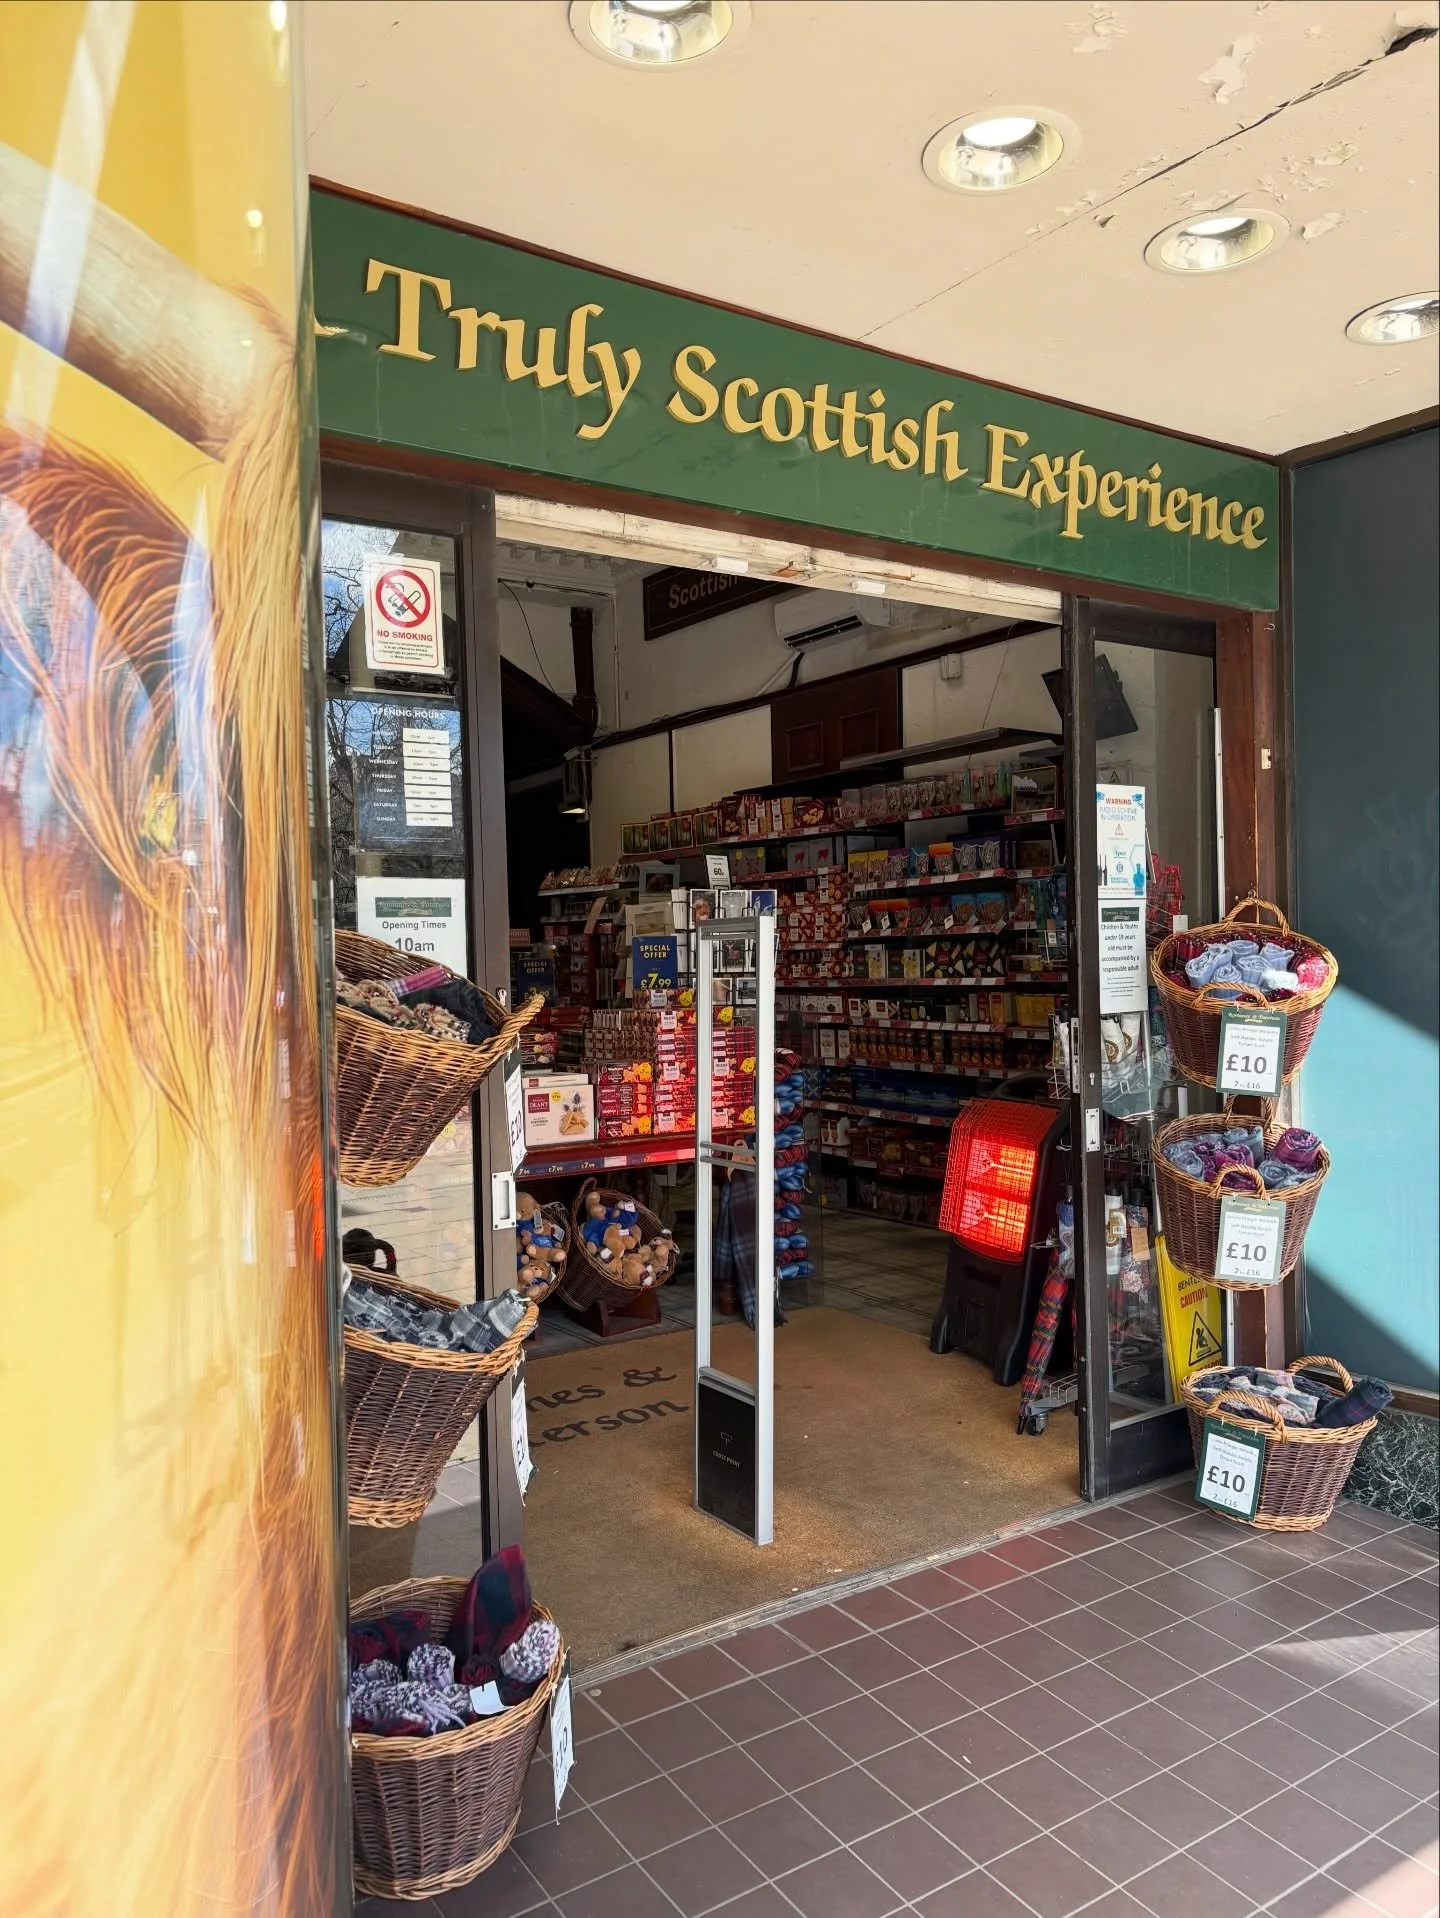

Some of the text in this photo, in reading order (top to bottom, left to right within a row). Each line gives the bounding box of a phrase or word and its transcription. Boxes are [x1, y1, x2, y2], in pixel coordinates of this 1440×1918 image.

[364, 259, 1268, 550] Truly Scottish Experience
[377, 629, 433, 642] NO SMOKING
[371, 707, 445, 719] OPENING HOURS
[1107, 814, 1136, 822] OPERATION
[382, 921, 447, 930] Opening Times
[395, 938, 435, 952] 10am
[640, 944, 670, 952] SPECIAL
[643, 951, 667, 959] OFFER
[1102, 965, 1127, 973] responsible
[640, 973, 671, 989] £7.99
[1226, 1054, 1267, 1074] £10
[1226, 1242, 1267, 1262] £10
[1180, 1287, 1208, 1308] CAUTION
[622, 1366, 677, 1388] &
[726, 1456, 741, 1468] POINT
[1207, 1465, 1245, 1493] £10
[1223, 1498, 1238, 1508] £16
